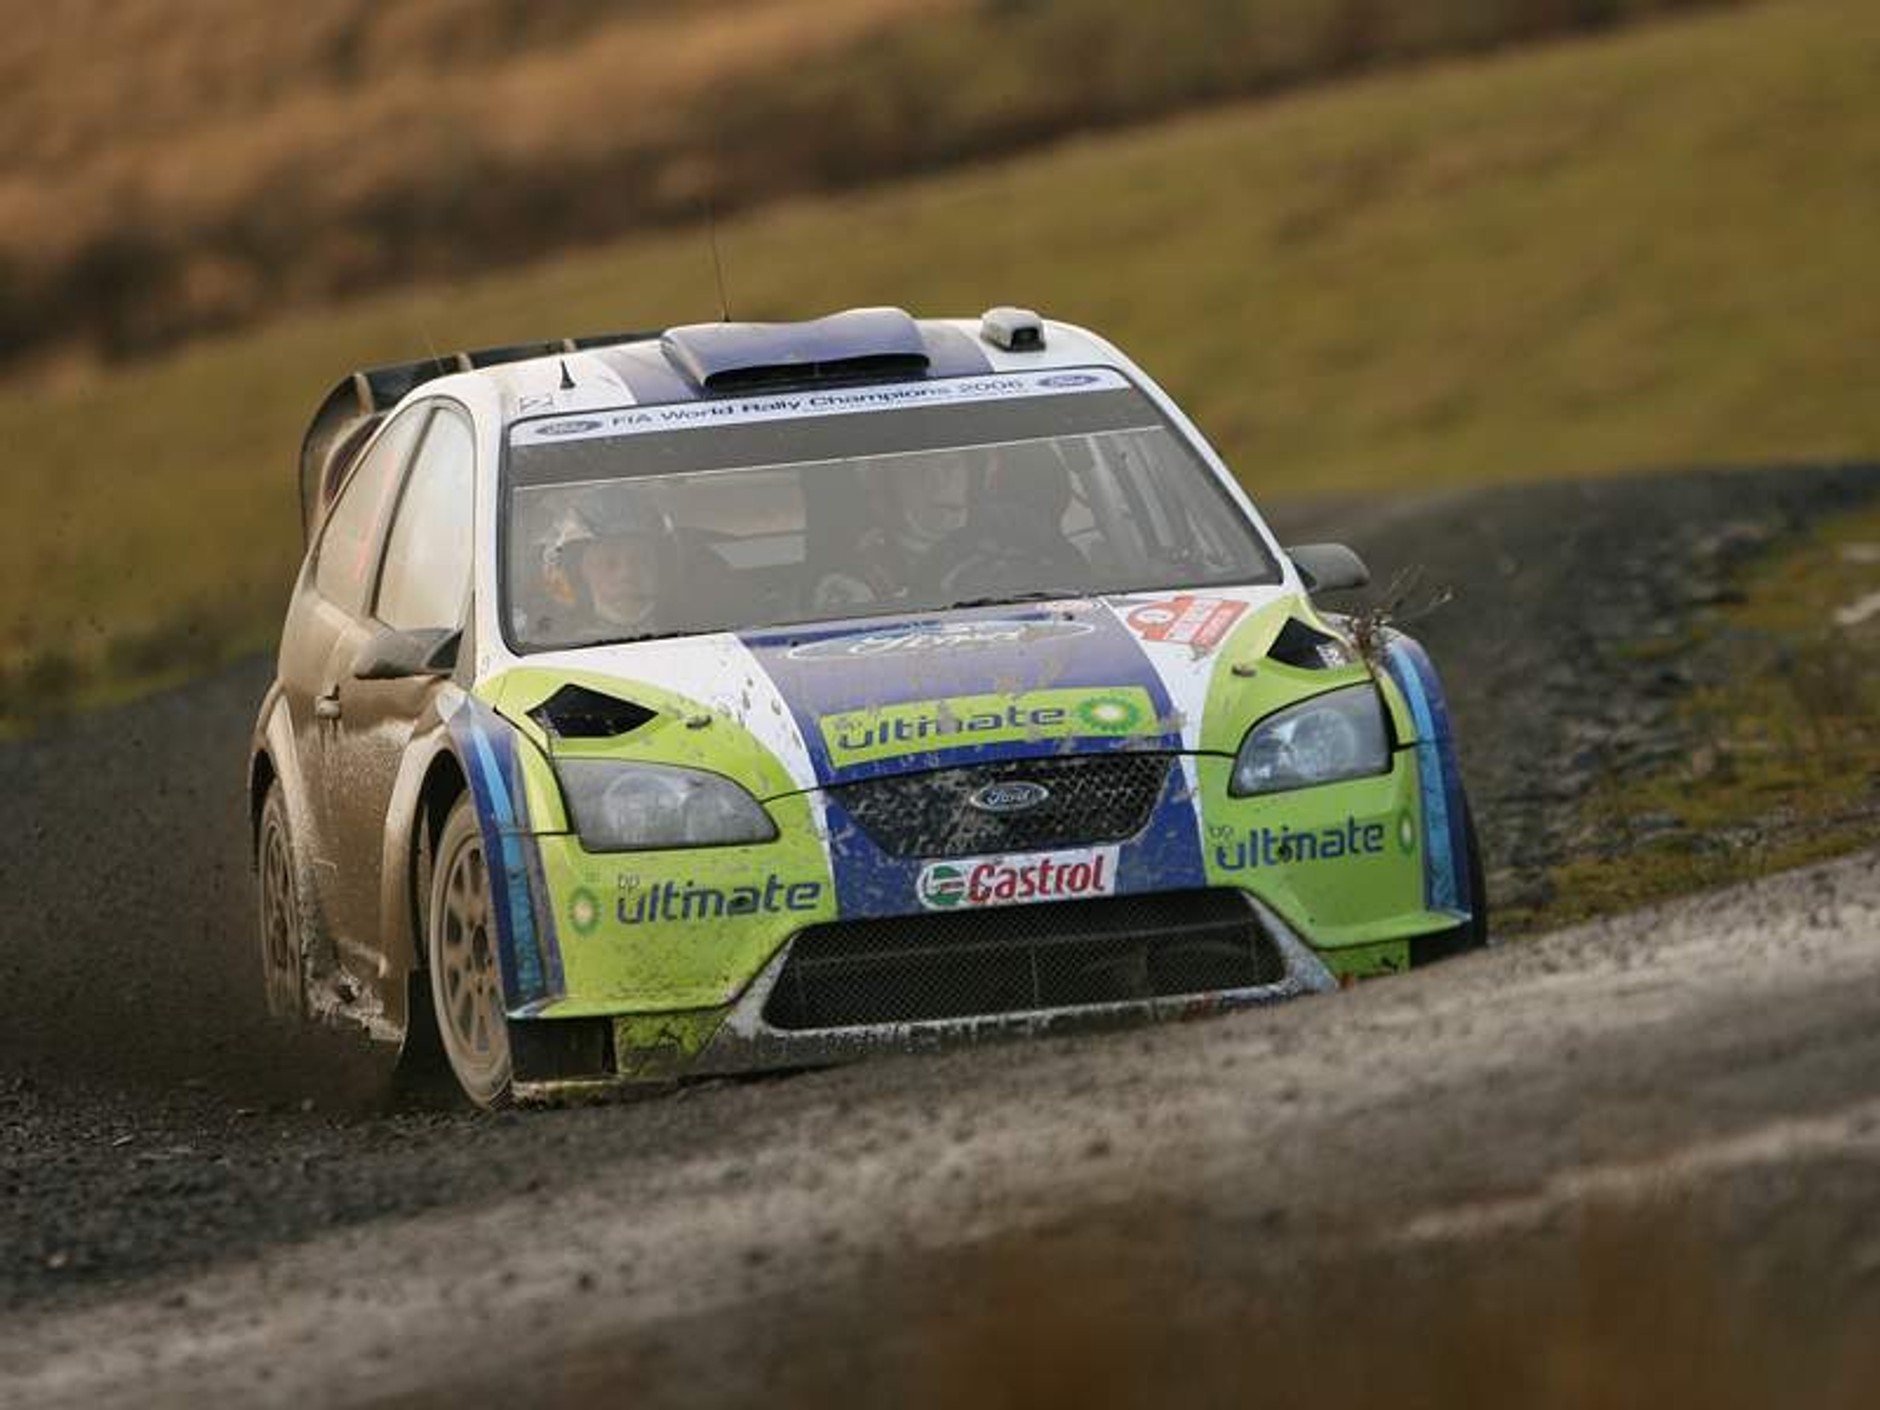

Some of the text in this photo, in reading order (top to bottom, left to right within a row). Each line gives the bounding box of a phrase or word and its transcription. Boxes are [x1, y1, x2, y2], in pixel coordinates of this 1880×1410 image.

[612, 412, 651, 427] FIA
[661, 406, 734, 421] World
[742, 399, 800, 414] Rally
[810, 387, 950, 406] Champions
[1215, 816, 1384, 871] ultimate
[616, 874, 821, 925] ultimate
[968, 855, 1105, 902] Castrol
